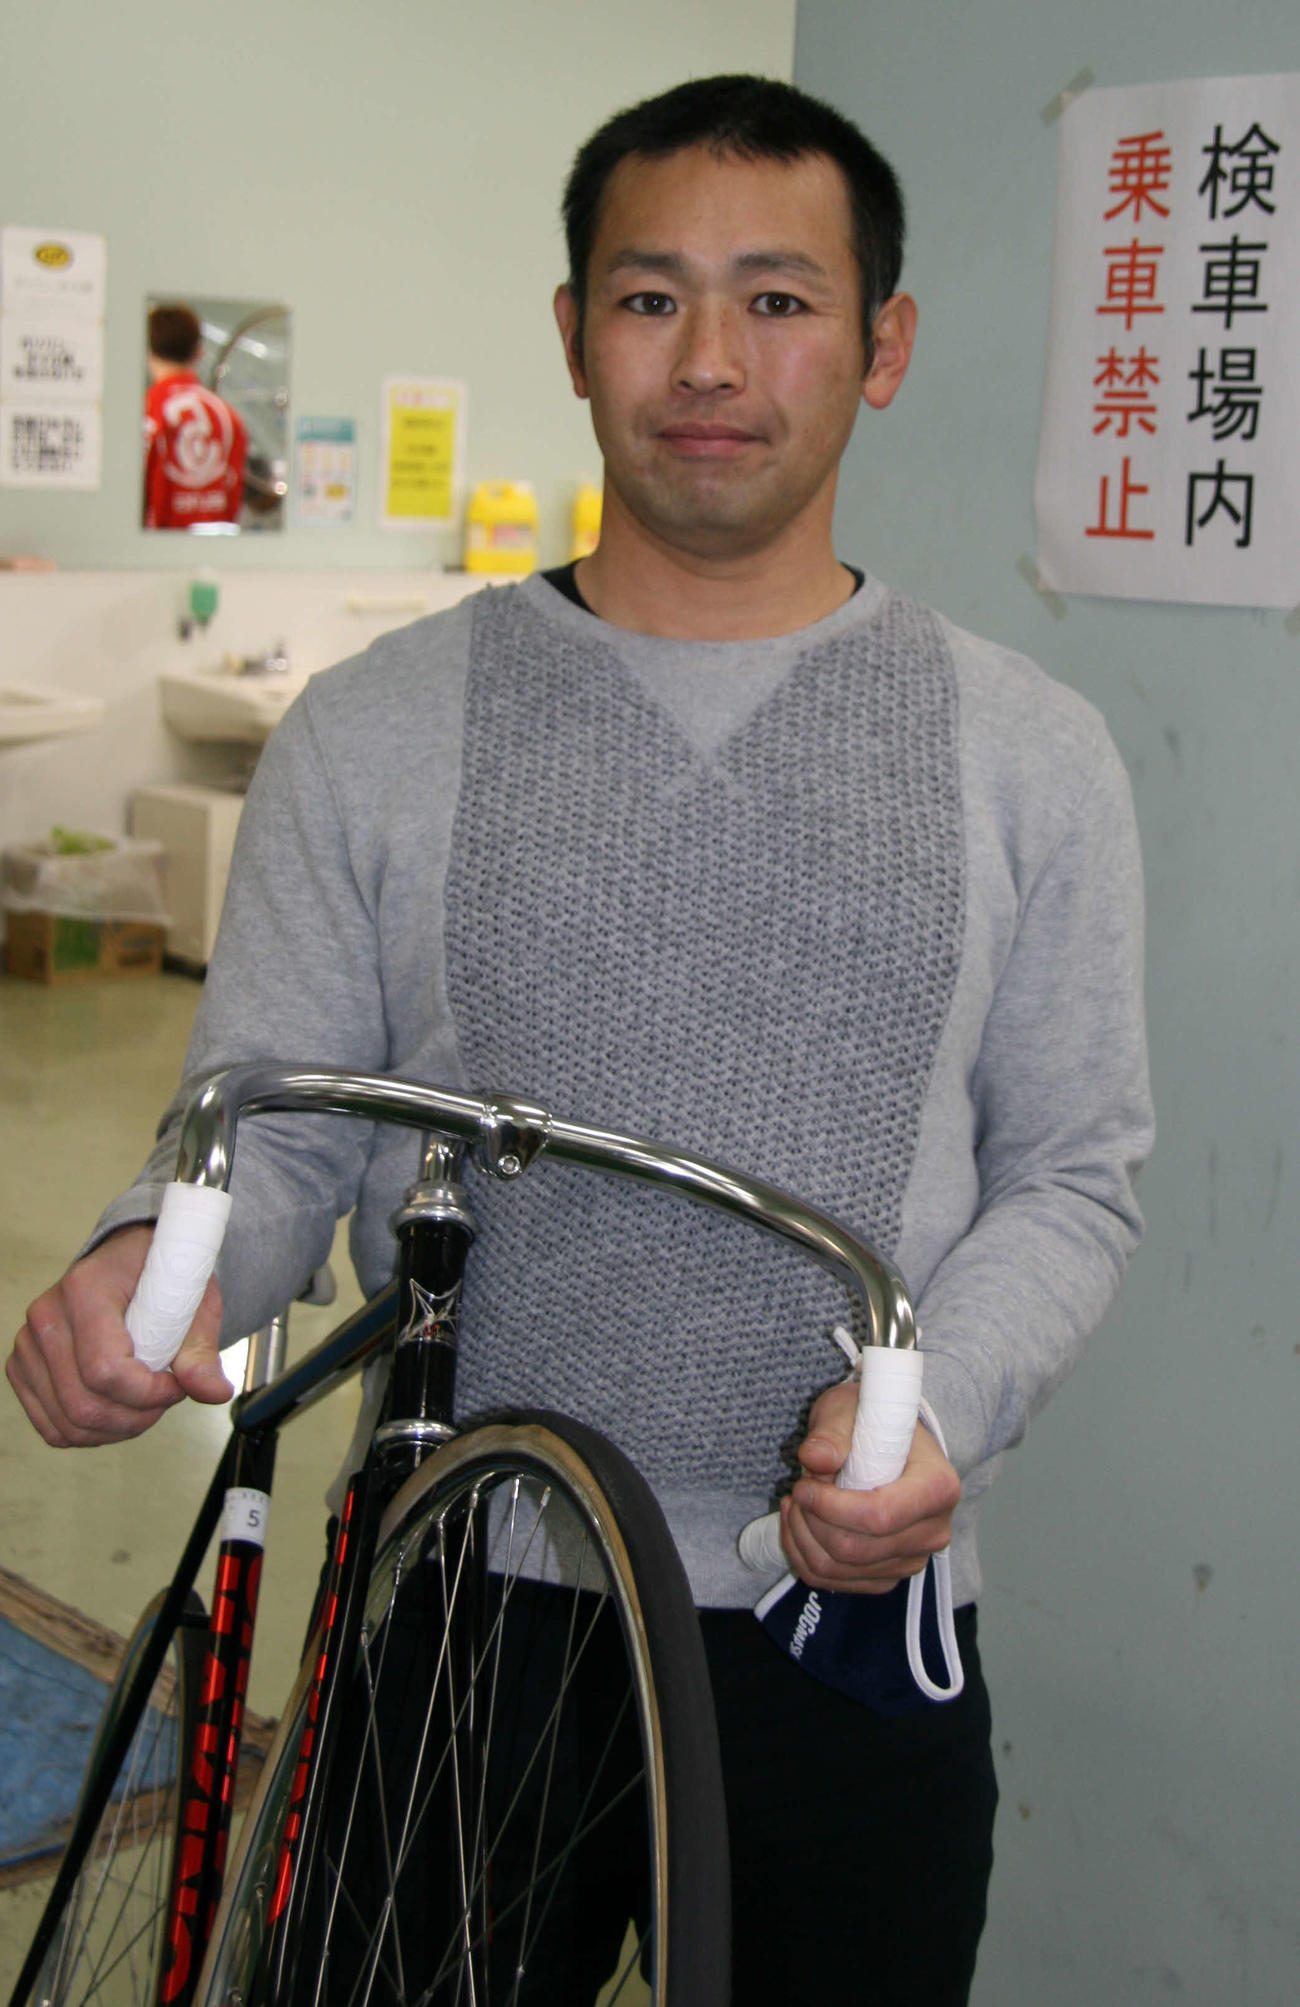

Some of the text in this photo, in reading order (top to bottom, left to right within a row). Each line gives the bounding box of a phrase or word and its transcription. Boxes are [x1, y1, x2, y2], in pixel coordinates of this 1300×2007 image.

[1085, 130, 1172, 540] 乗車禁止
[1186, 122, 1281, 548] 検車場内
